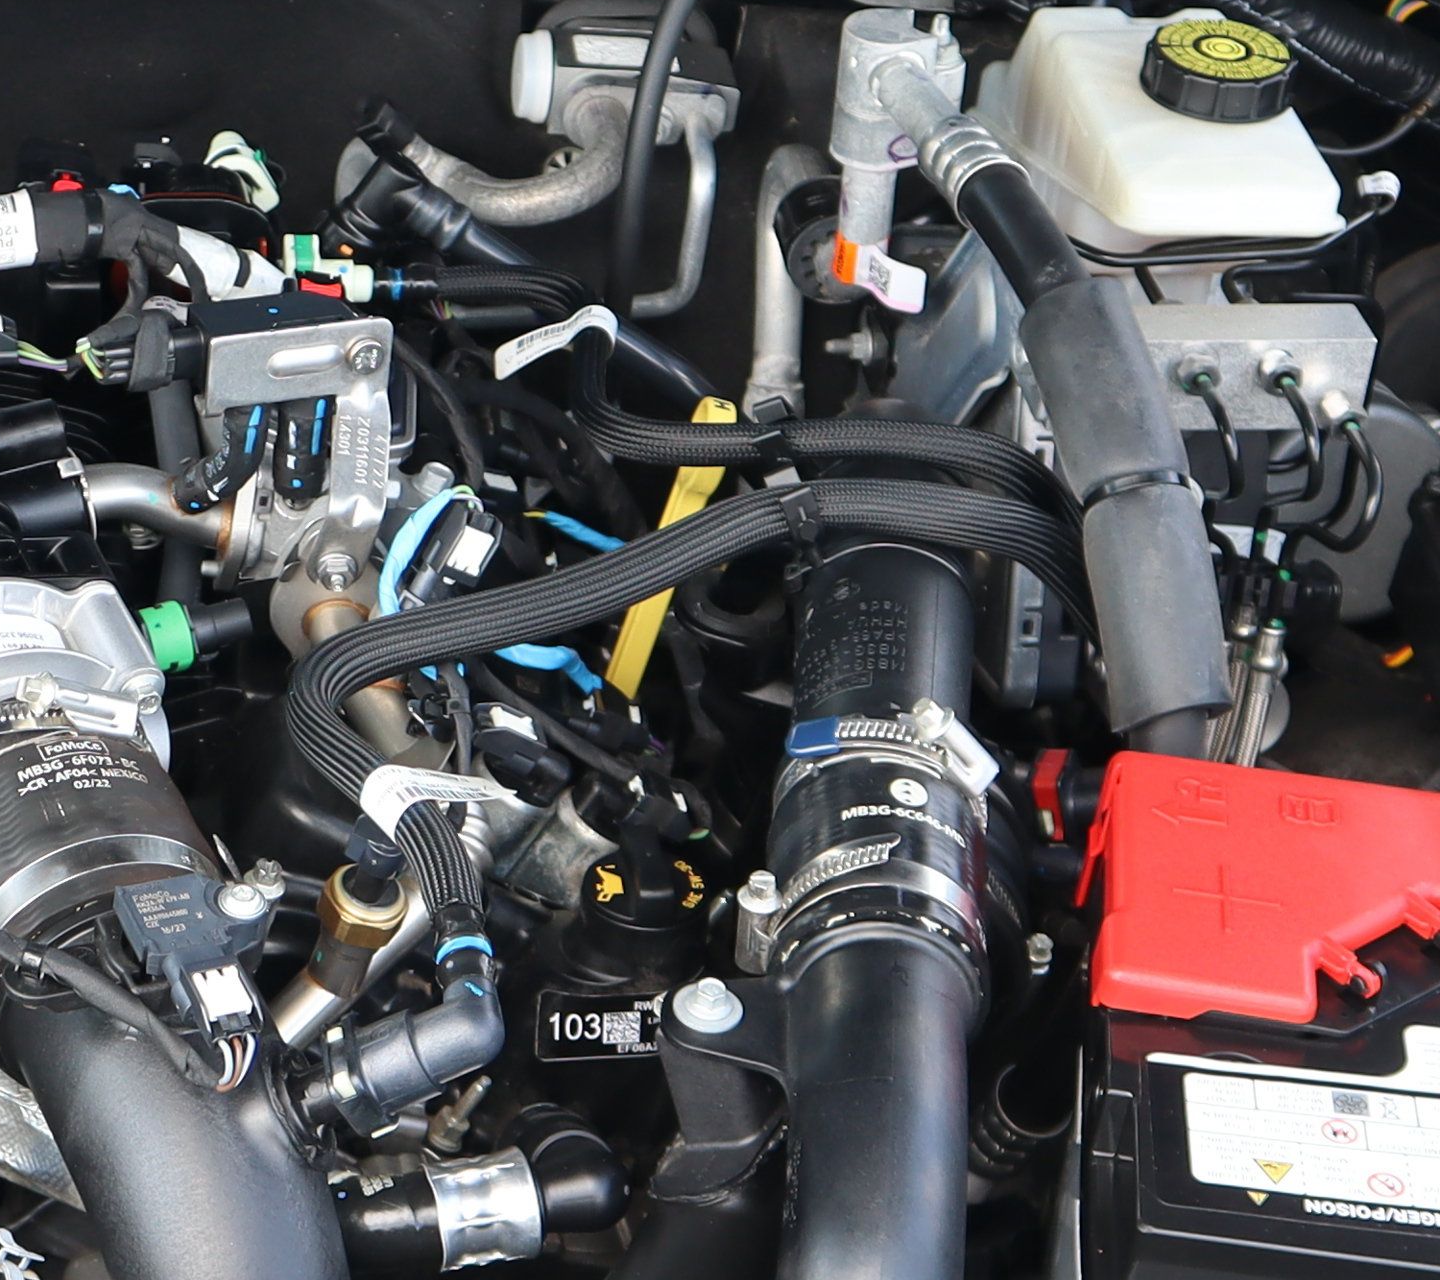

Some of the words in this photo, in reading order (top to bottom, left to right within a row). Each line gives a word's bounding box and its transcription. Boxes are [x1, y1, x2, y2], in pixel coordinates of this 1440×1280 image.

[44, 740, 103, 756] FoMoCo
[101, 766, 149, 784] MEXICO
[549, 1011, 602, 1042] 103
